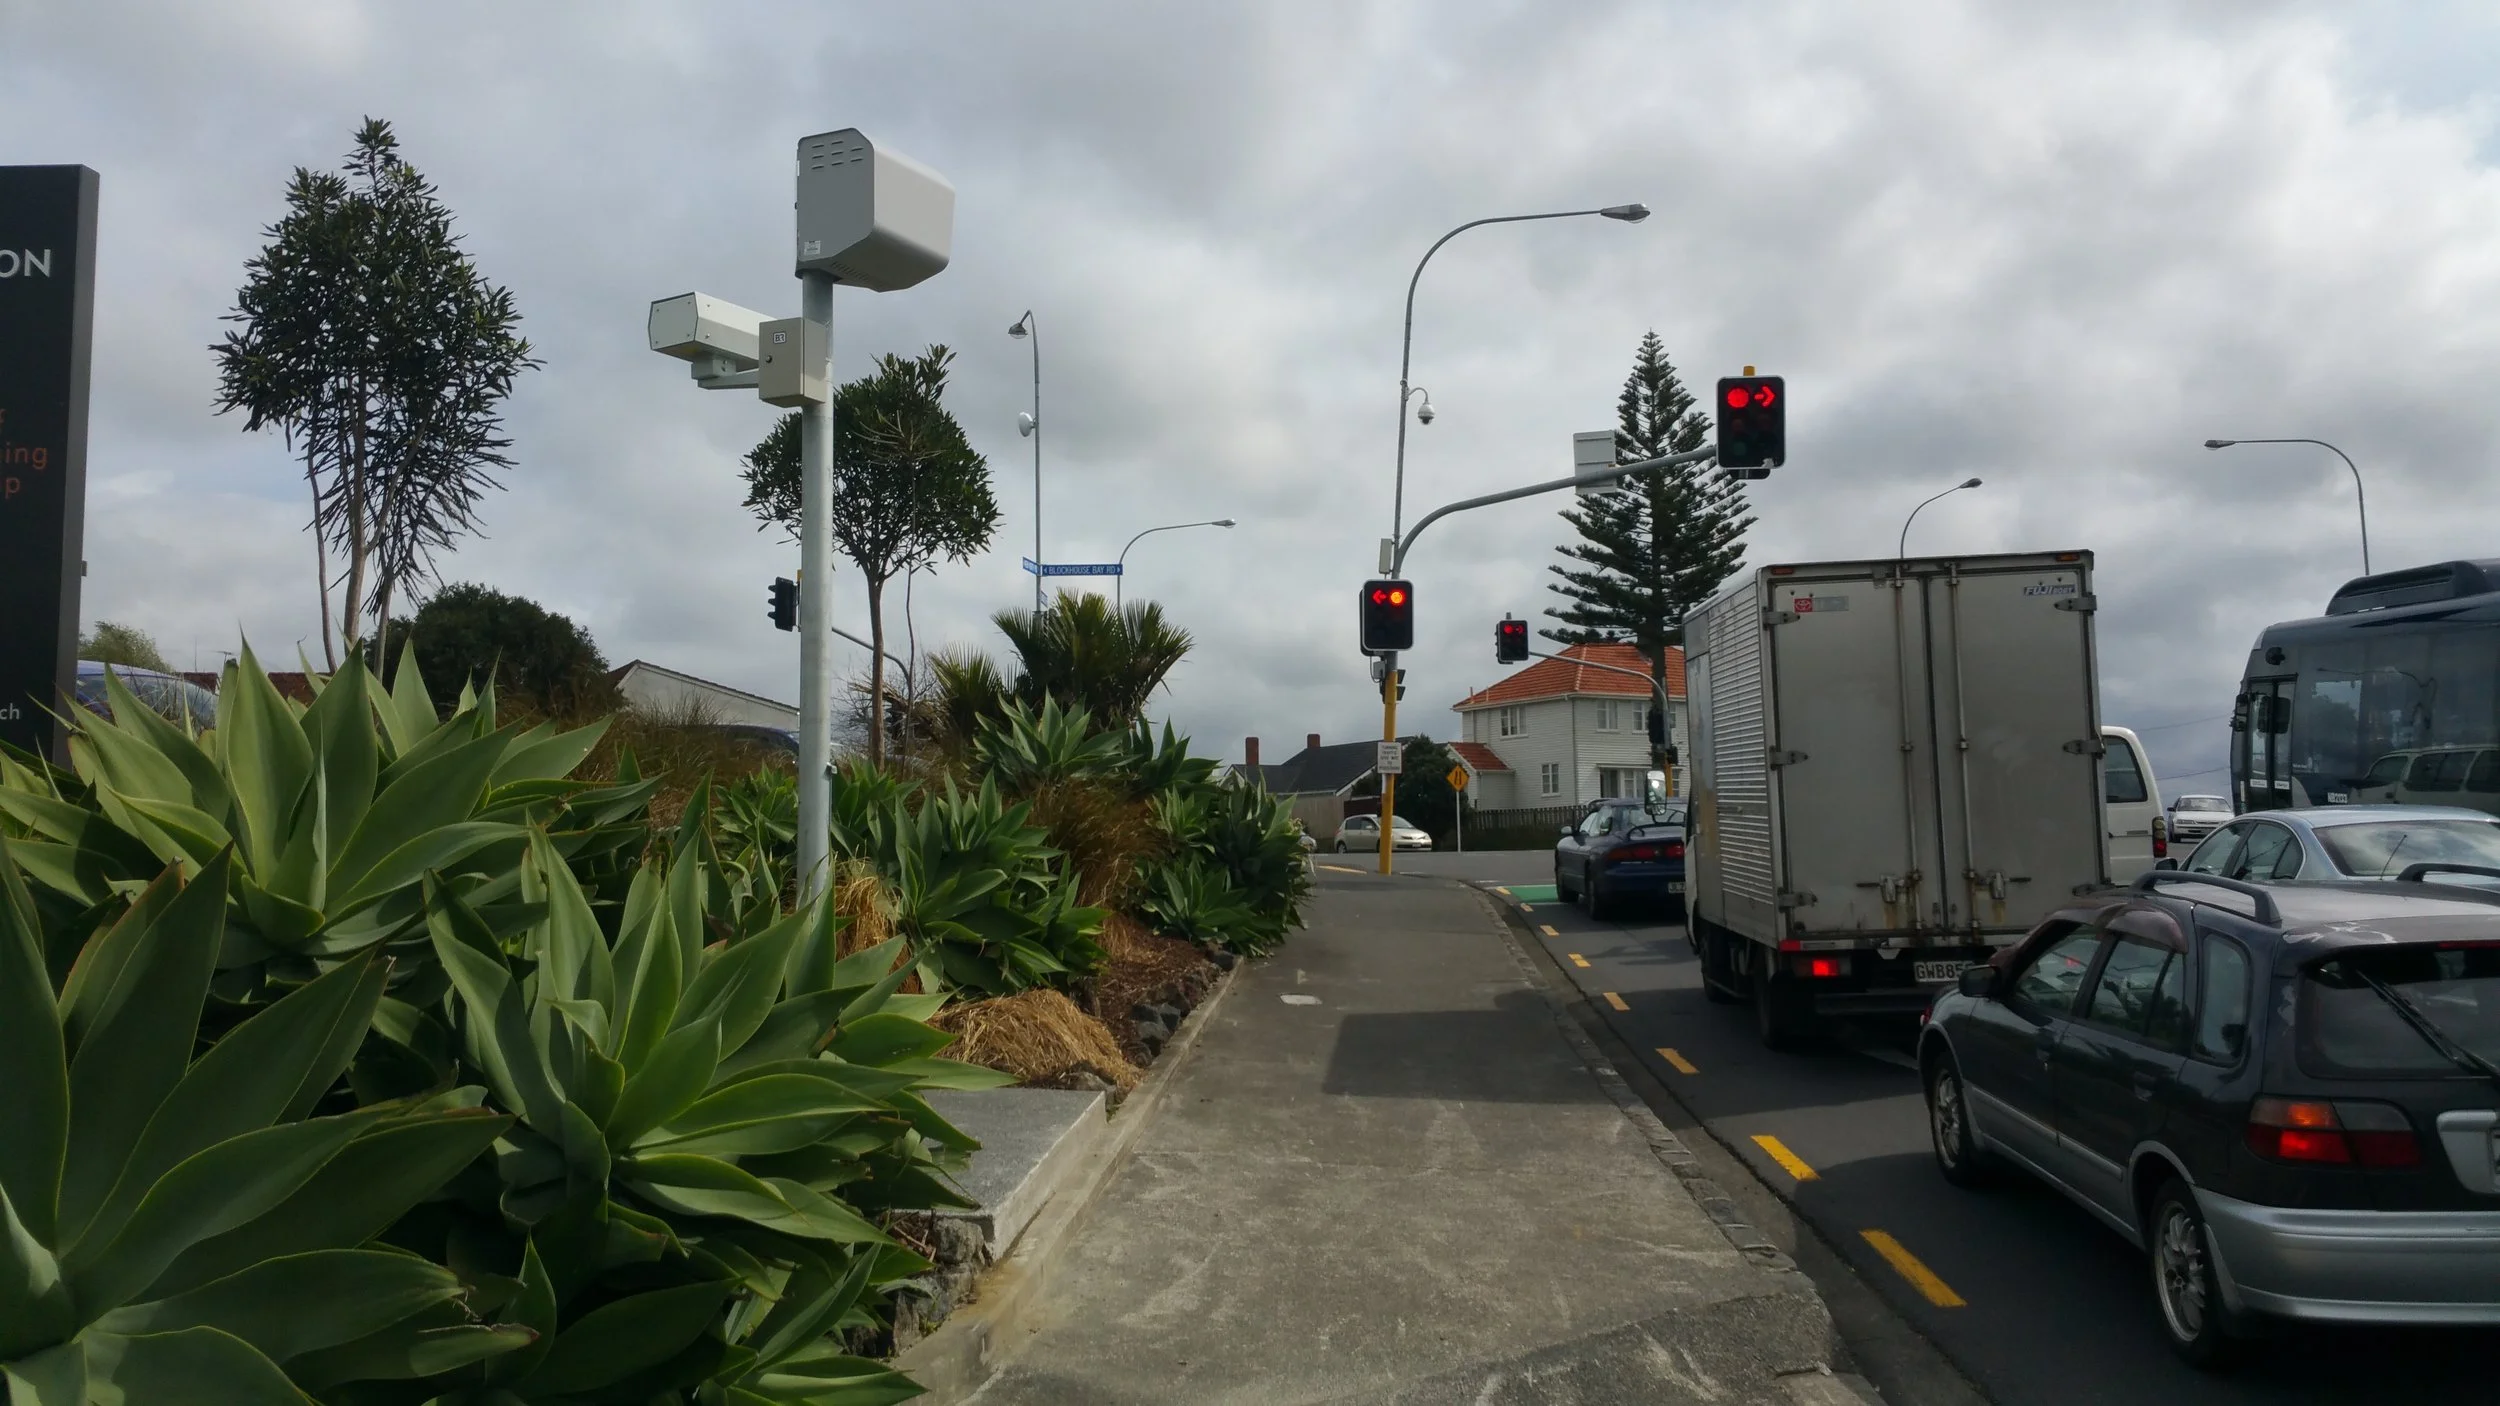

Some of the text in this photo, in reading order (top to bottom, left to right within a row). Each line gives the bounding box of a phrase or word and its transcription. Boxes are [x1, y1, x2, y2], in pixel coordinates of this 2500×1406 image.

[0, 249, 51, 278] ON
[1048, 566, 1115, 575] BLOCKHOUSE BAY RD
[2025, 585, 2053, 596] FUJI
[1916, 963, 1971, 979] GWB85
